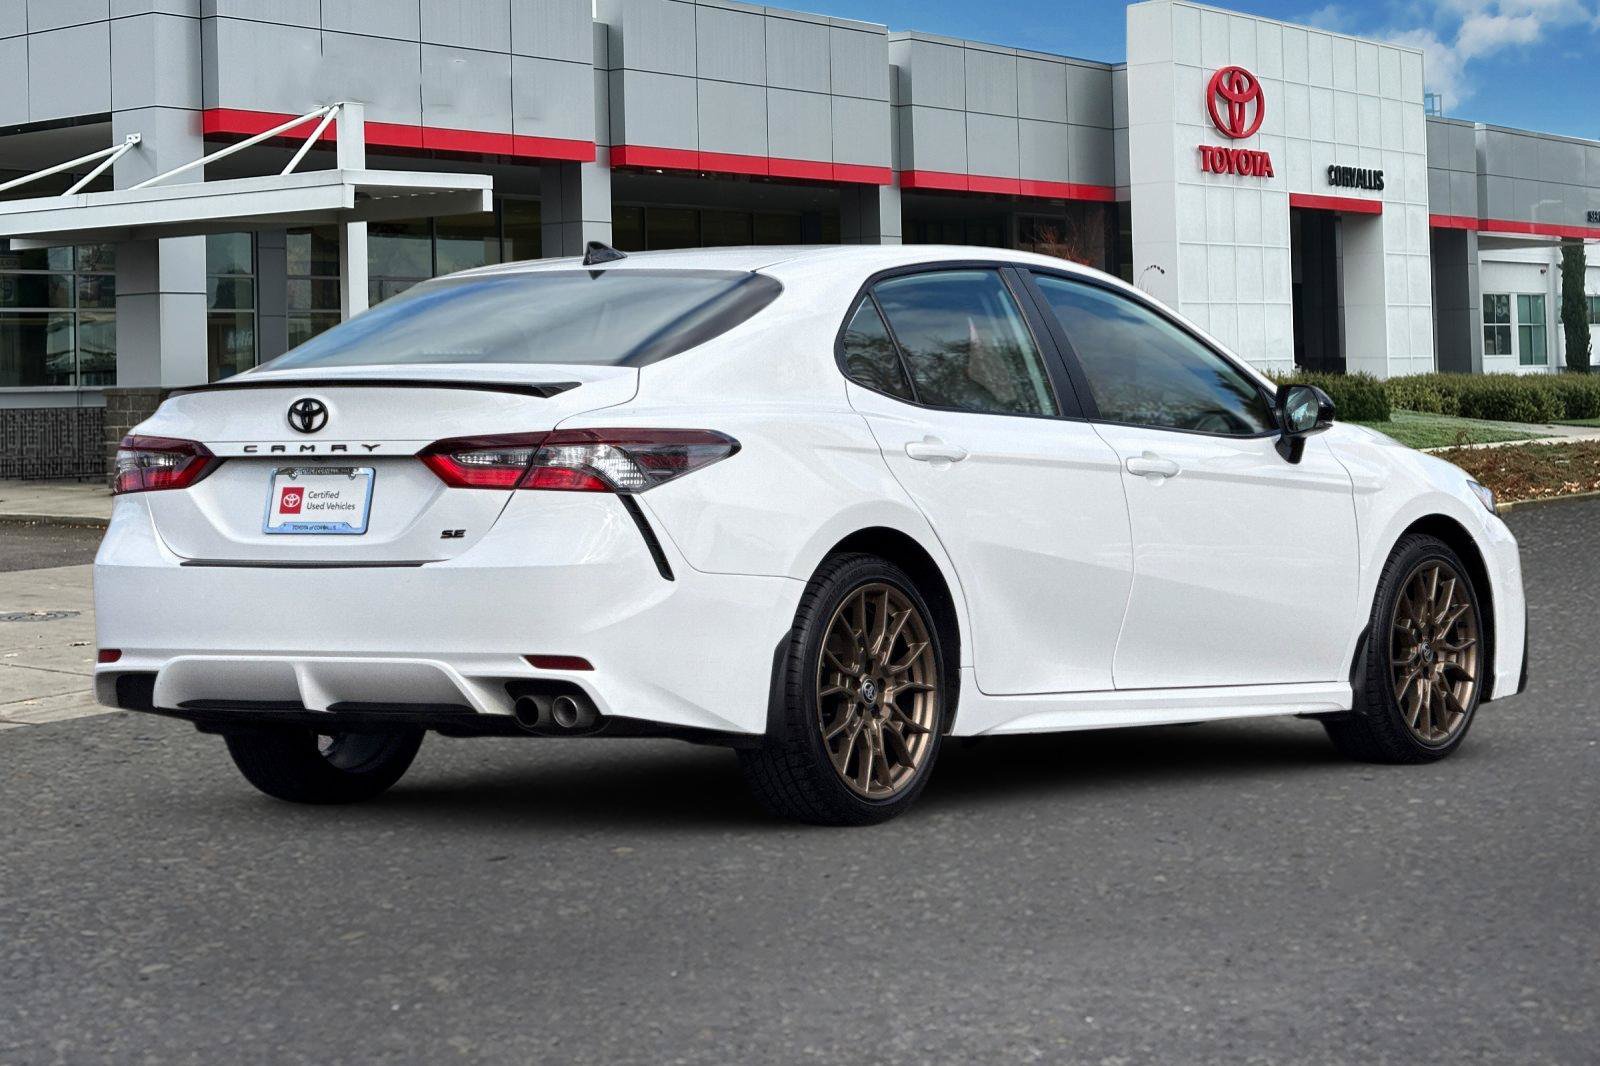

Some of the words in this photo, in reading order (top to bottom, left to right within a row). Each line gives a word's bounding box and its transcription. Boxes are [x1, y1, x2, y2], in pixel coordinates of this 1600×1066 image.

[1199, 145, 1275, 178] TOYOTA
[1327, 164, 1385, 191] CORVALLIS
[243, 444, 380, 453] CAMRY
[308, 490, 340, 499] Certified
[306, 502, 326, 510] Used
[327, 502, 356, 510] Vehicles
[440, 529, 466, 539] SE
